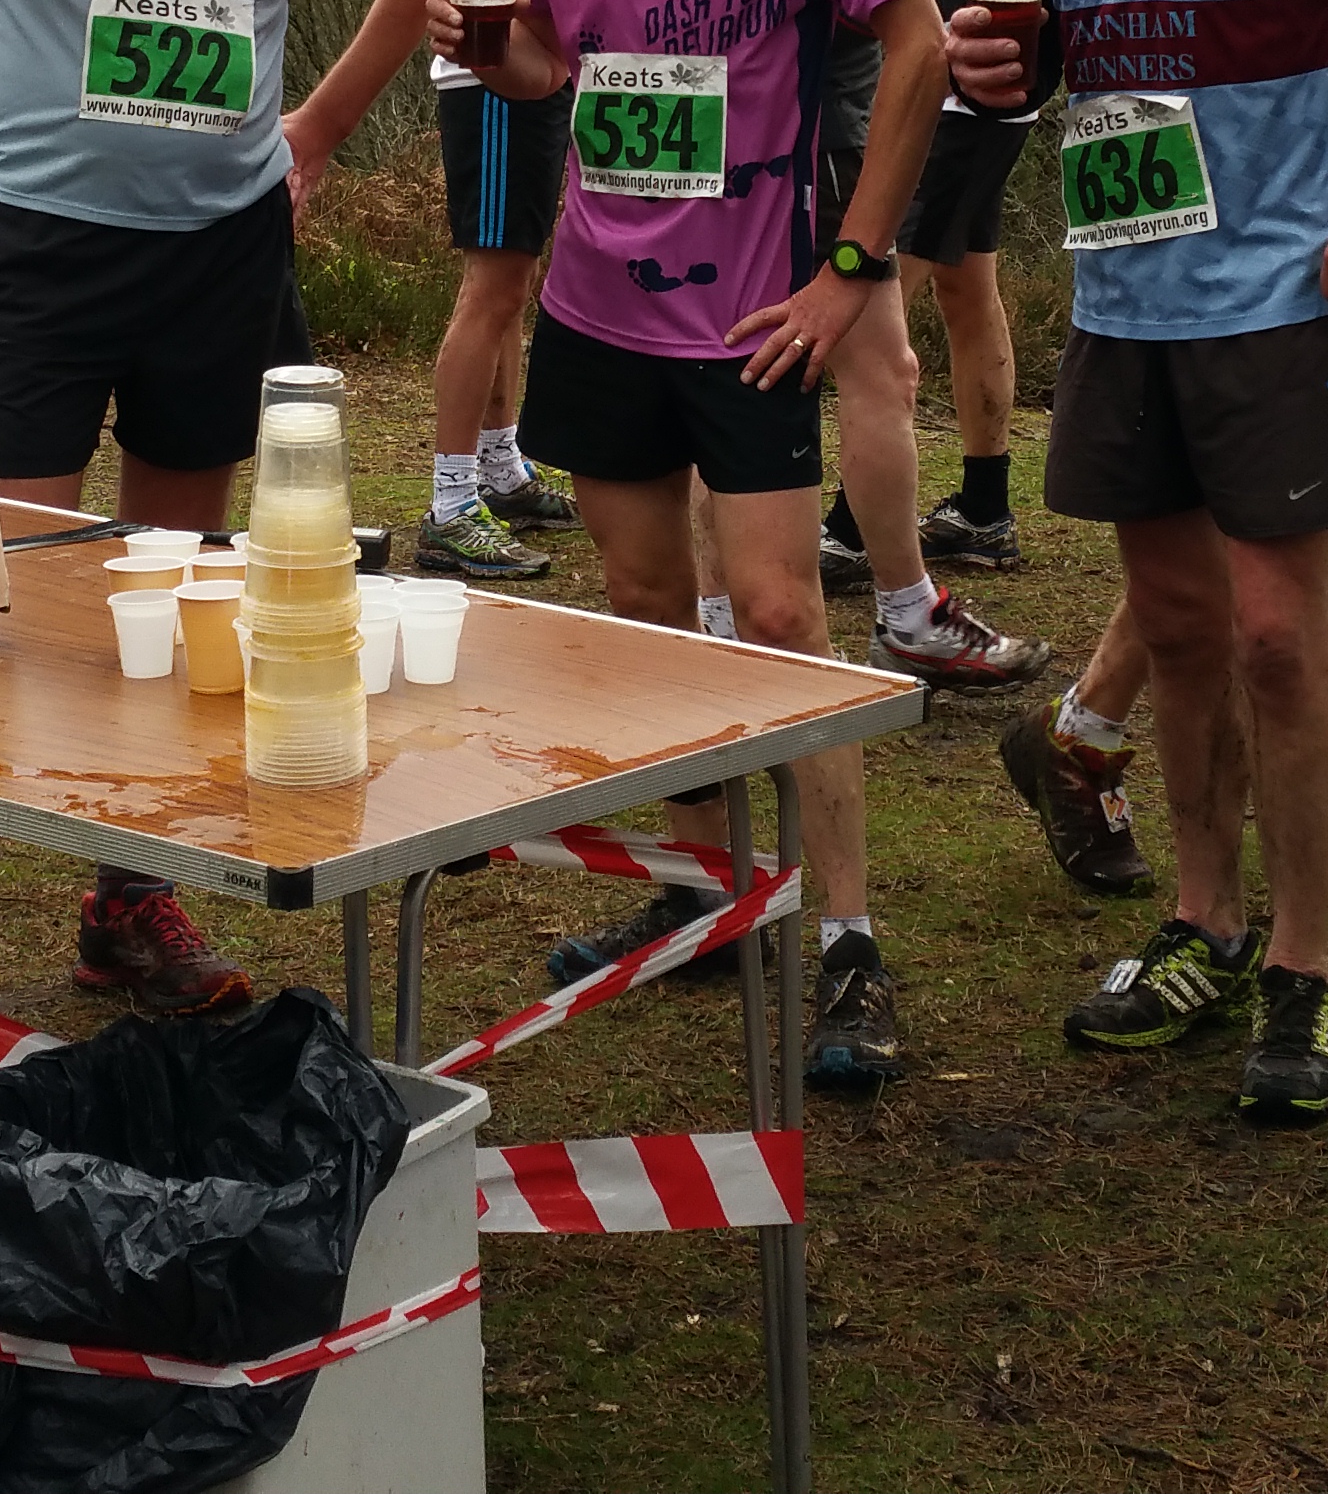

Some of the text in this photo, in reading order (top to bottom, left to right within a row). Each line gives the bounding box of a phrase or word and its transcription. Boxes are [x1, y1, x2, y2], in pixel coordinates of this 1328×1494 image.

[110, 21, 231, 106] 522
[593, 65, 663, 89] Keats
[86, 100, 242, 131] www.boxingdayrun.org
[1073, 110, 1129, 140] Keats
[593, 94, 699, 171] 534
[584, 172, 719, 192] www.boxingdayrun.org
[1077, 131, 1179, 222] 636
